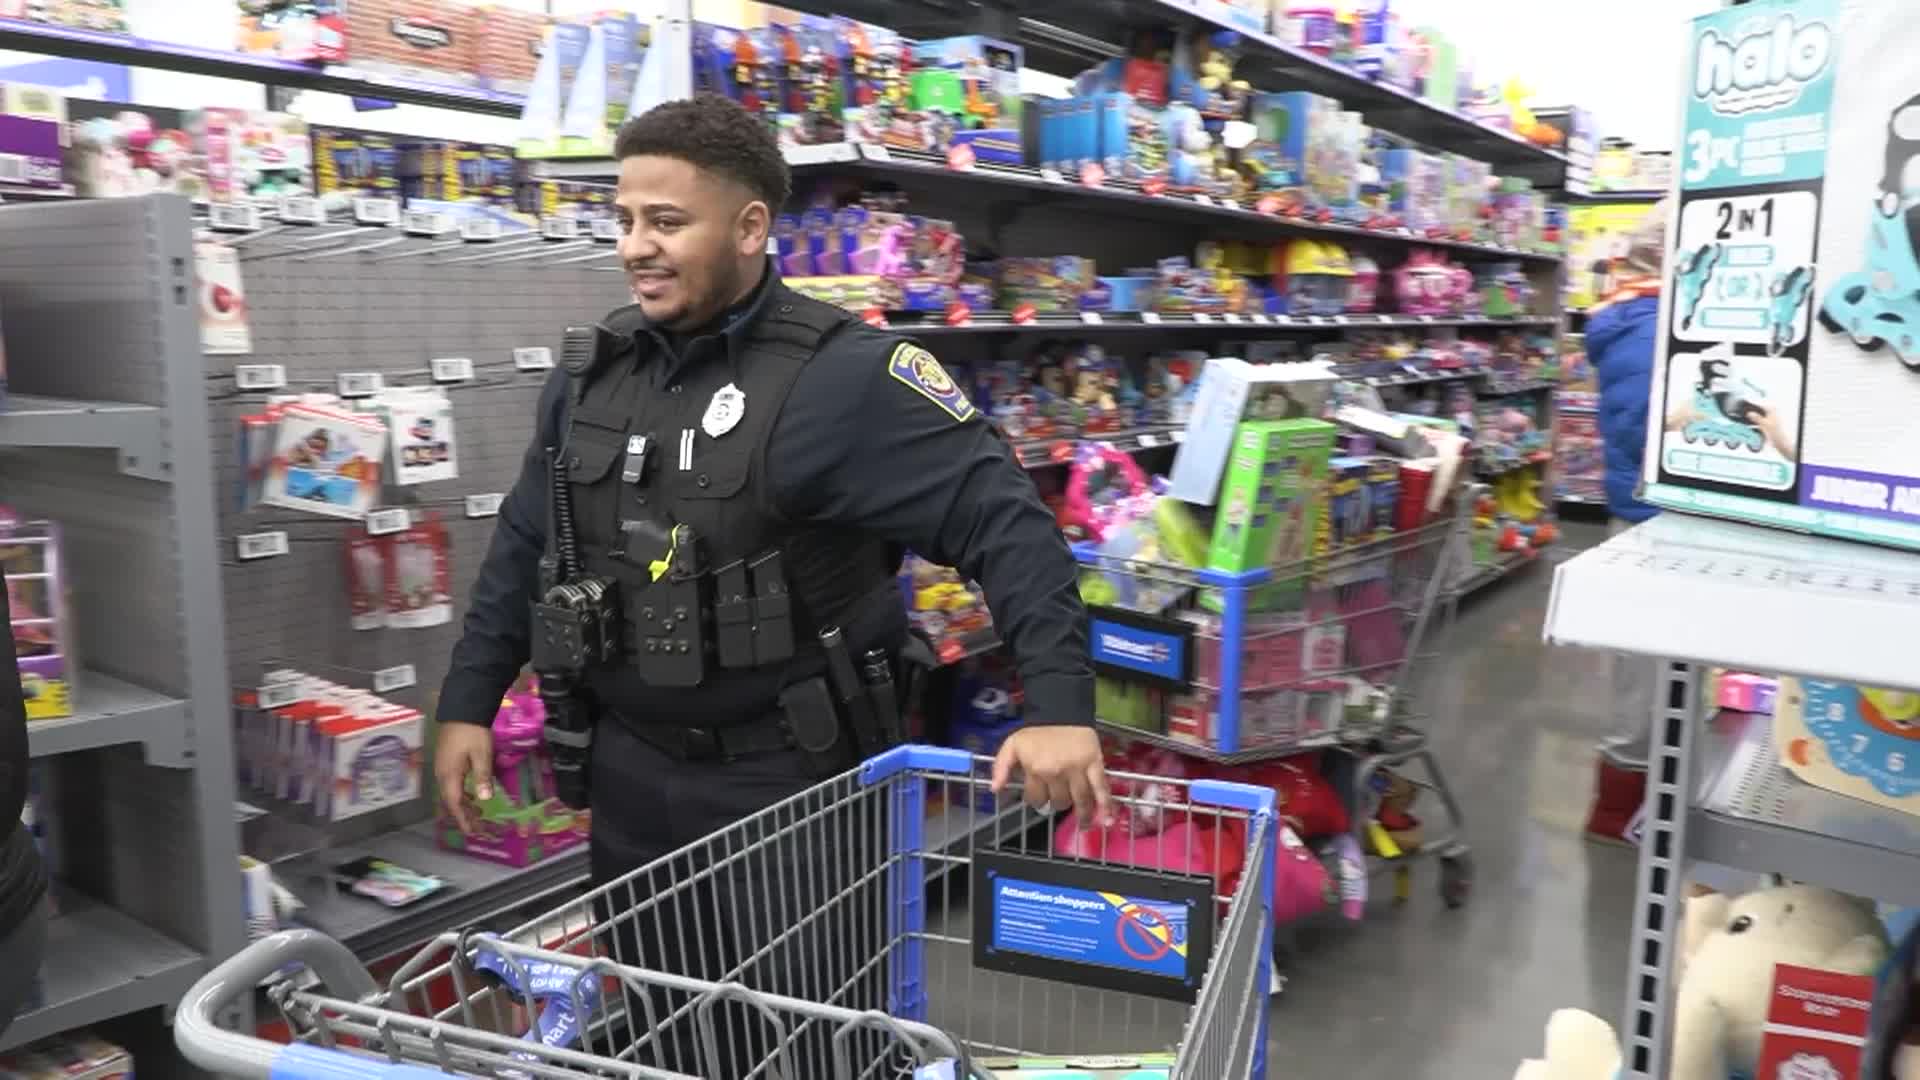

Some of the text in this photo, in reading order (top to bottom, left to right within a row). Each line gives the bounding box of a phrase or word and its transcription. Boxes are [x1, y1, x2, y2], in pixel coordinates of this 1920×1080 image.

[1695, 13, 1831, 99] halo
[1716, 198, 1774, 240] 2 IN 1
[1852, 733, 1869, 753] 7
[1001, 886, 1105, 911] Attention shoppers
